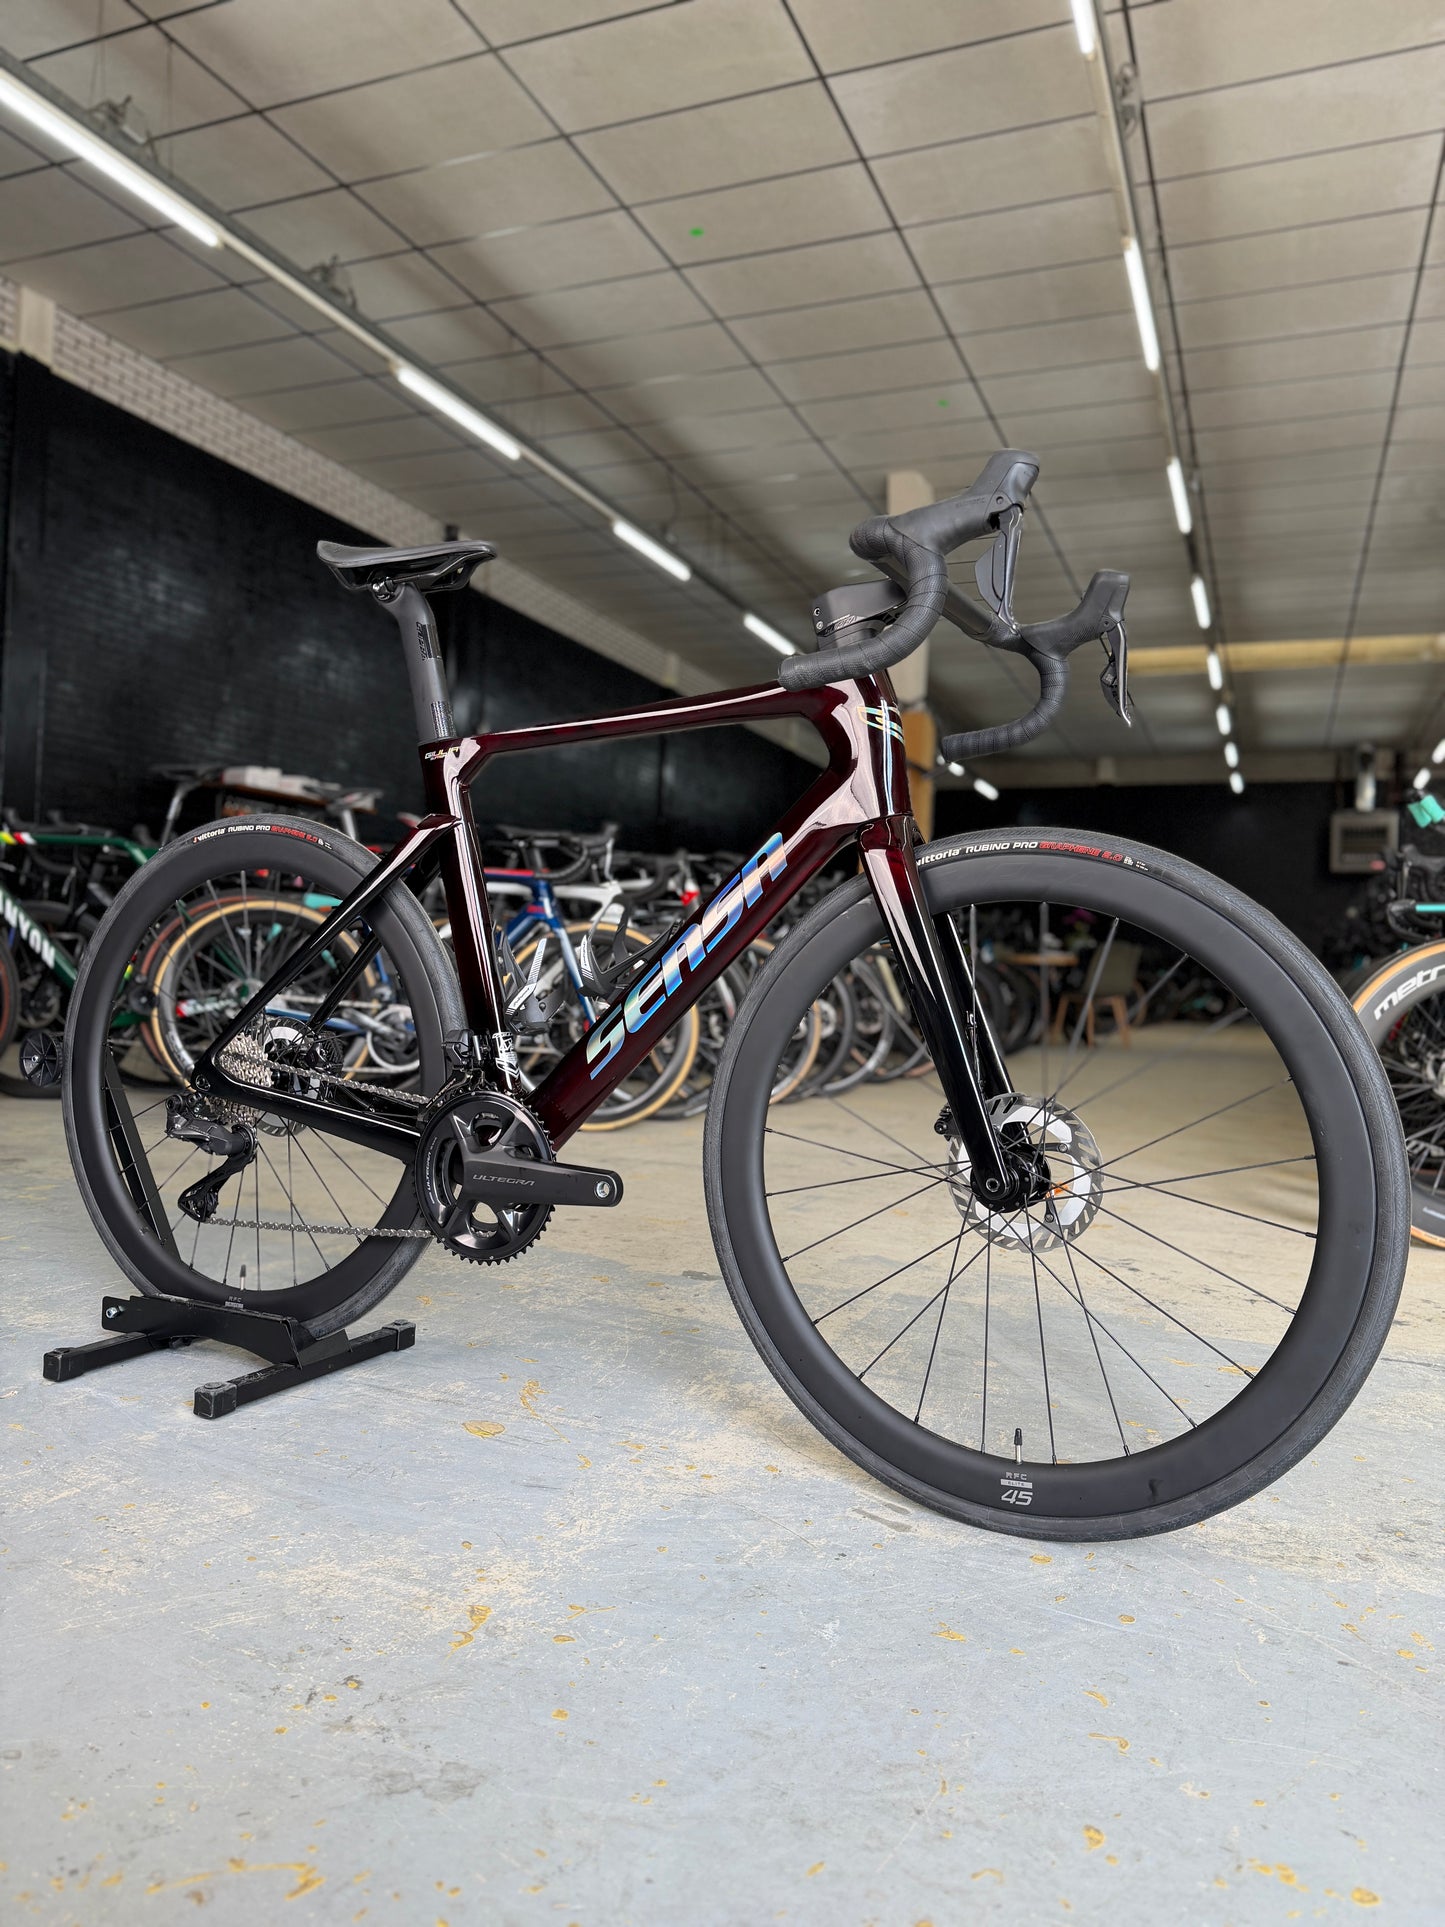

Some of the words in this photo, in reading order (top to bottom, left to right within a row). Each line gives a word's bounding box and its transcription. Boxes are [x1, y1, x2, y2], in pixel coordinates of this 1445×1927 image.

[197, 828, 225, 842] vittoria
[227, 824, 255, 833] RUBINO
[965, 842, 1011, 854] RUBINO
[1012, 841, 1039, 850] PRO
[0, 889, 56, 969] NYON
[472, 1174, 536, 1186] ULTEGRA
[1005, 1472, 1027, 1480] RFC
[1001, 1489, 1033, 1506] 45
